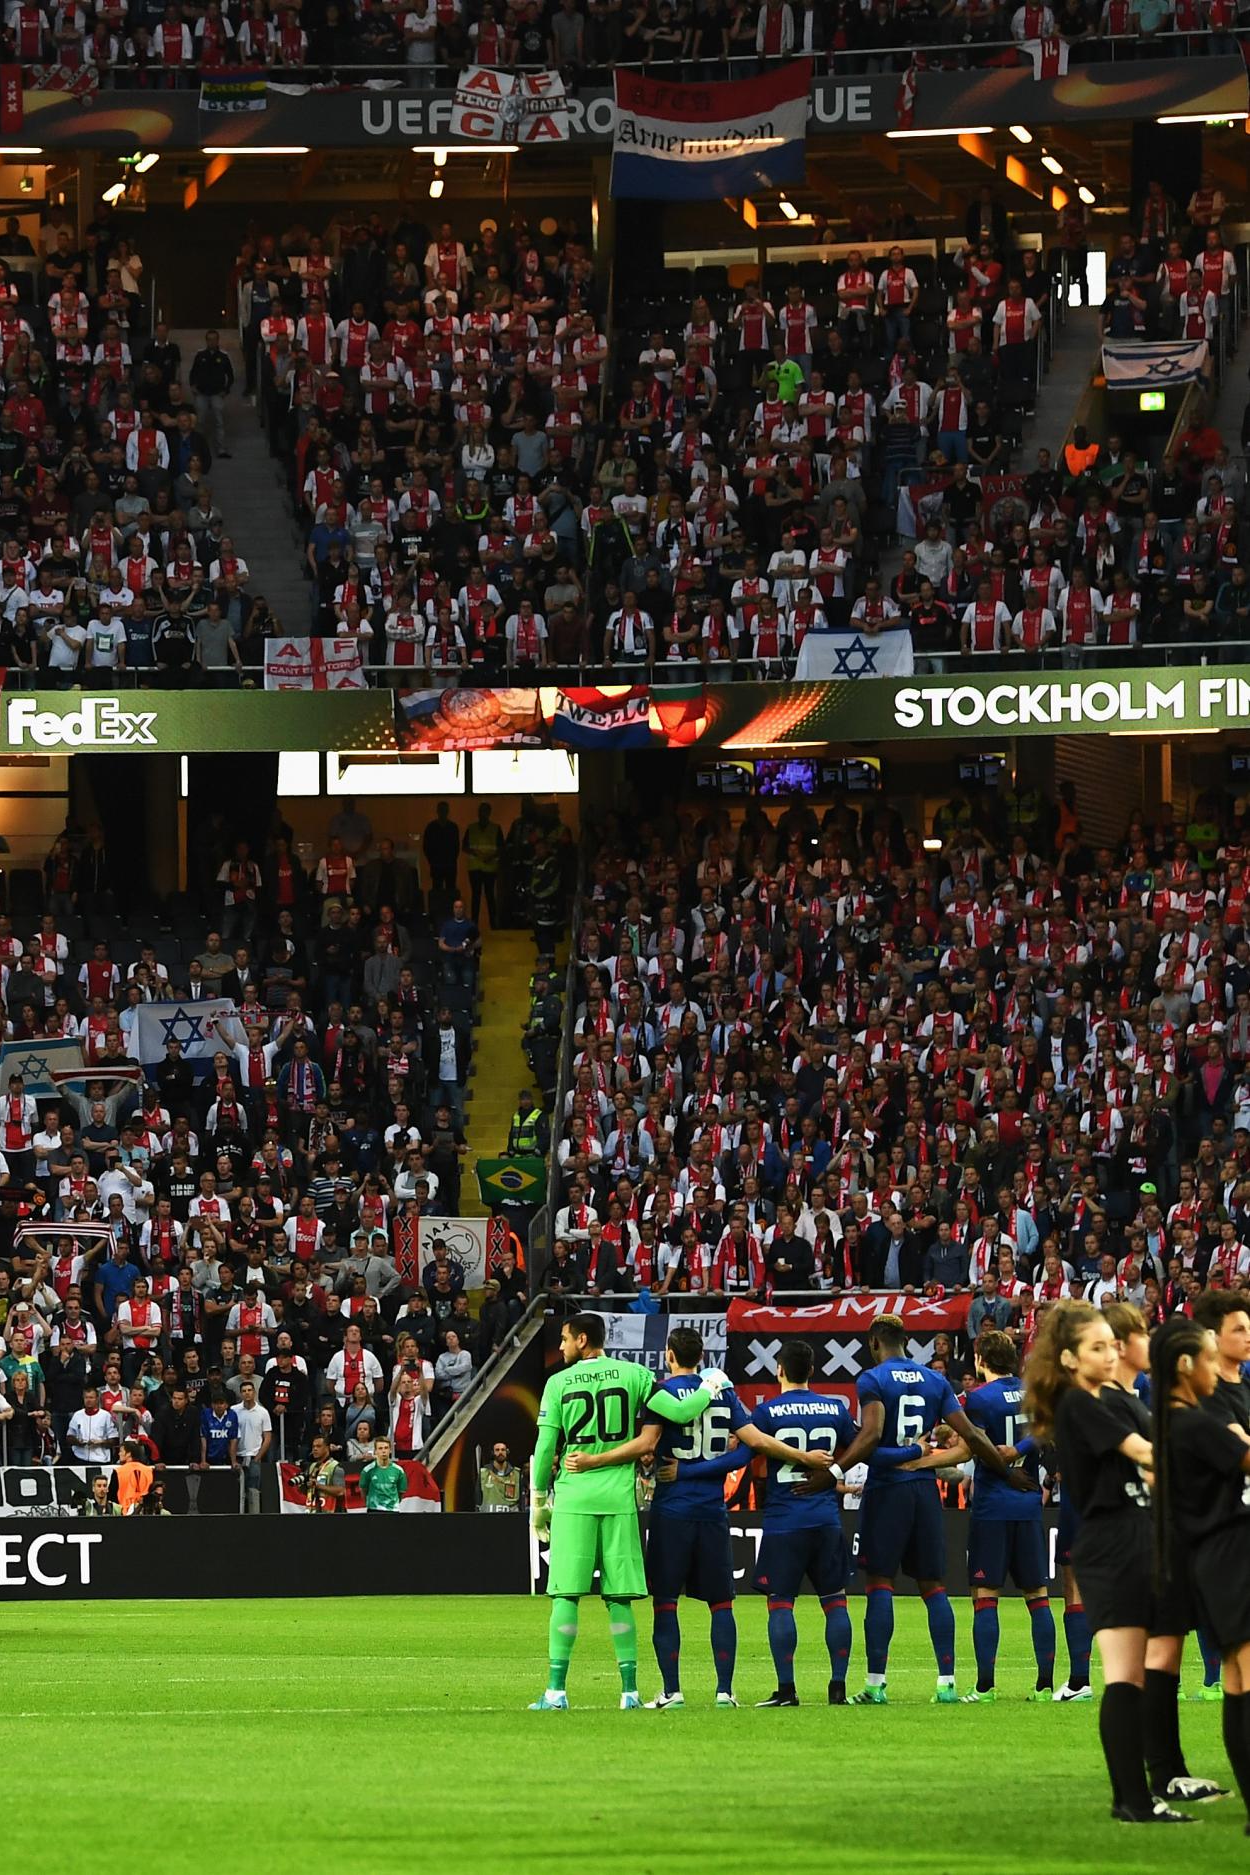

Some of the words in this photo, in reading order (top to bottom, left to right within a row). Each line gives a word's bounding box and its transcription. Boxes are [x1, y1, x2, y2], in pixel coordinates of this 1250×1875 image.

[361, 99, 453, 135] UEF
[8, 697, 158, 746] FedEx
[556, 691, 651, 727] TWELLO
[894, 680, 1185, 728] STOCKHOLM
[891, 1370, 925, 1384] POGBA
[562, 1387, 630, 1446] 20
[768, 1402, 839, 1418] MKHITARYAN
[896, 1394, 926, 1447] 6
[209, 1429, 229, 1439] TDK
[671, 1406, 732, 1461] 36
